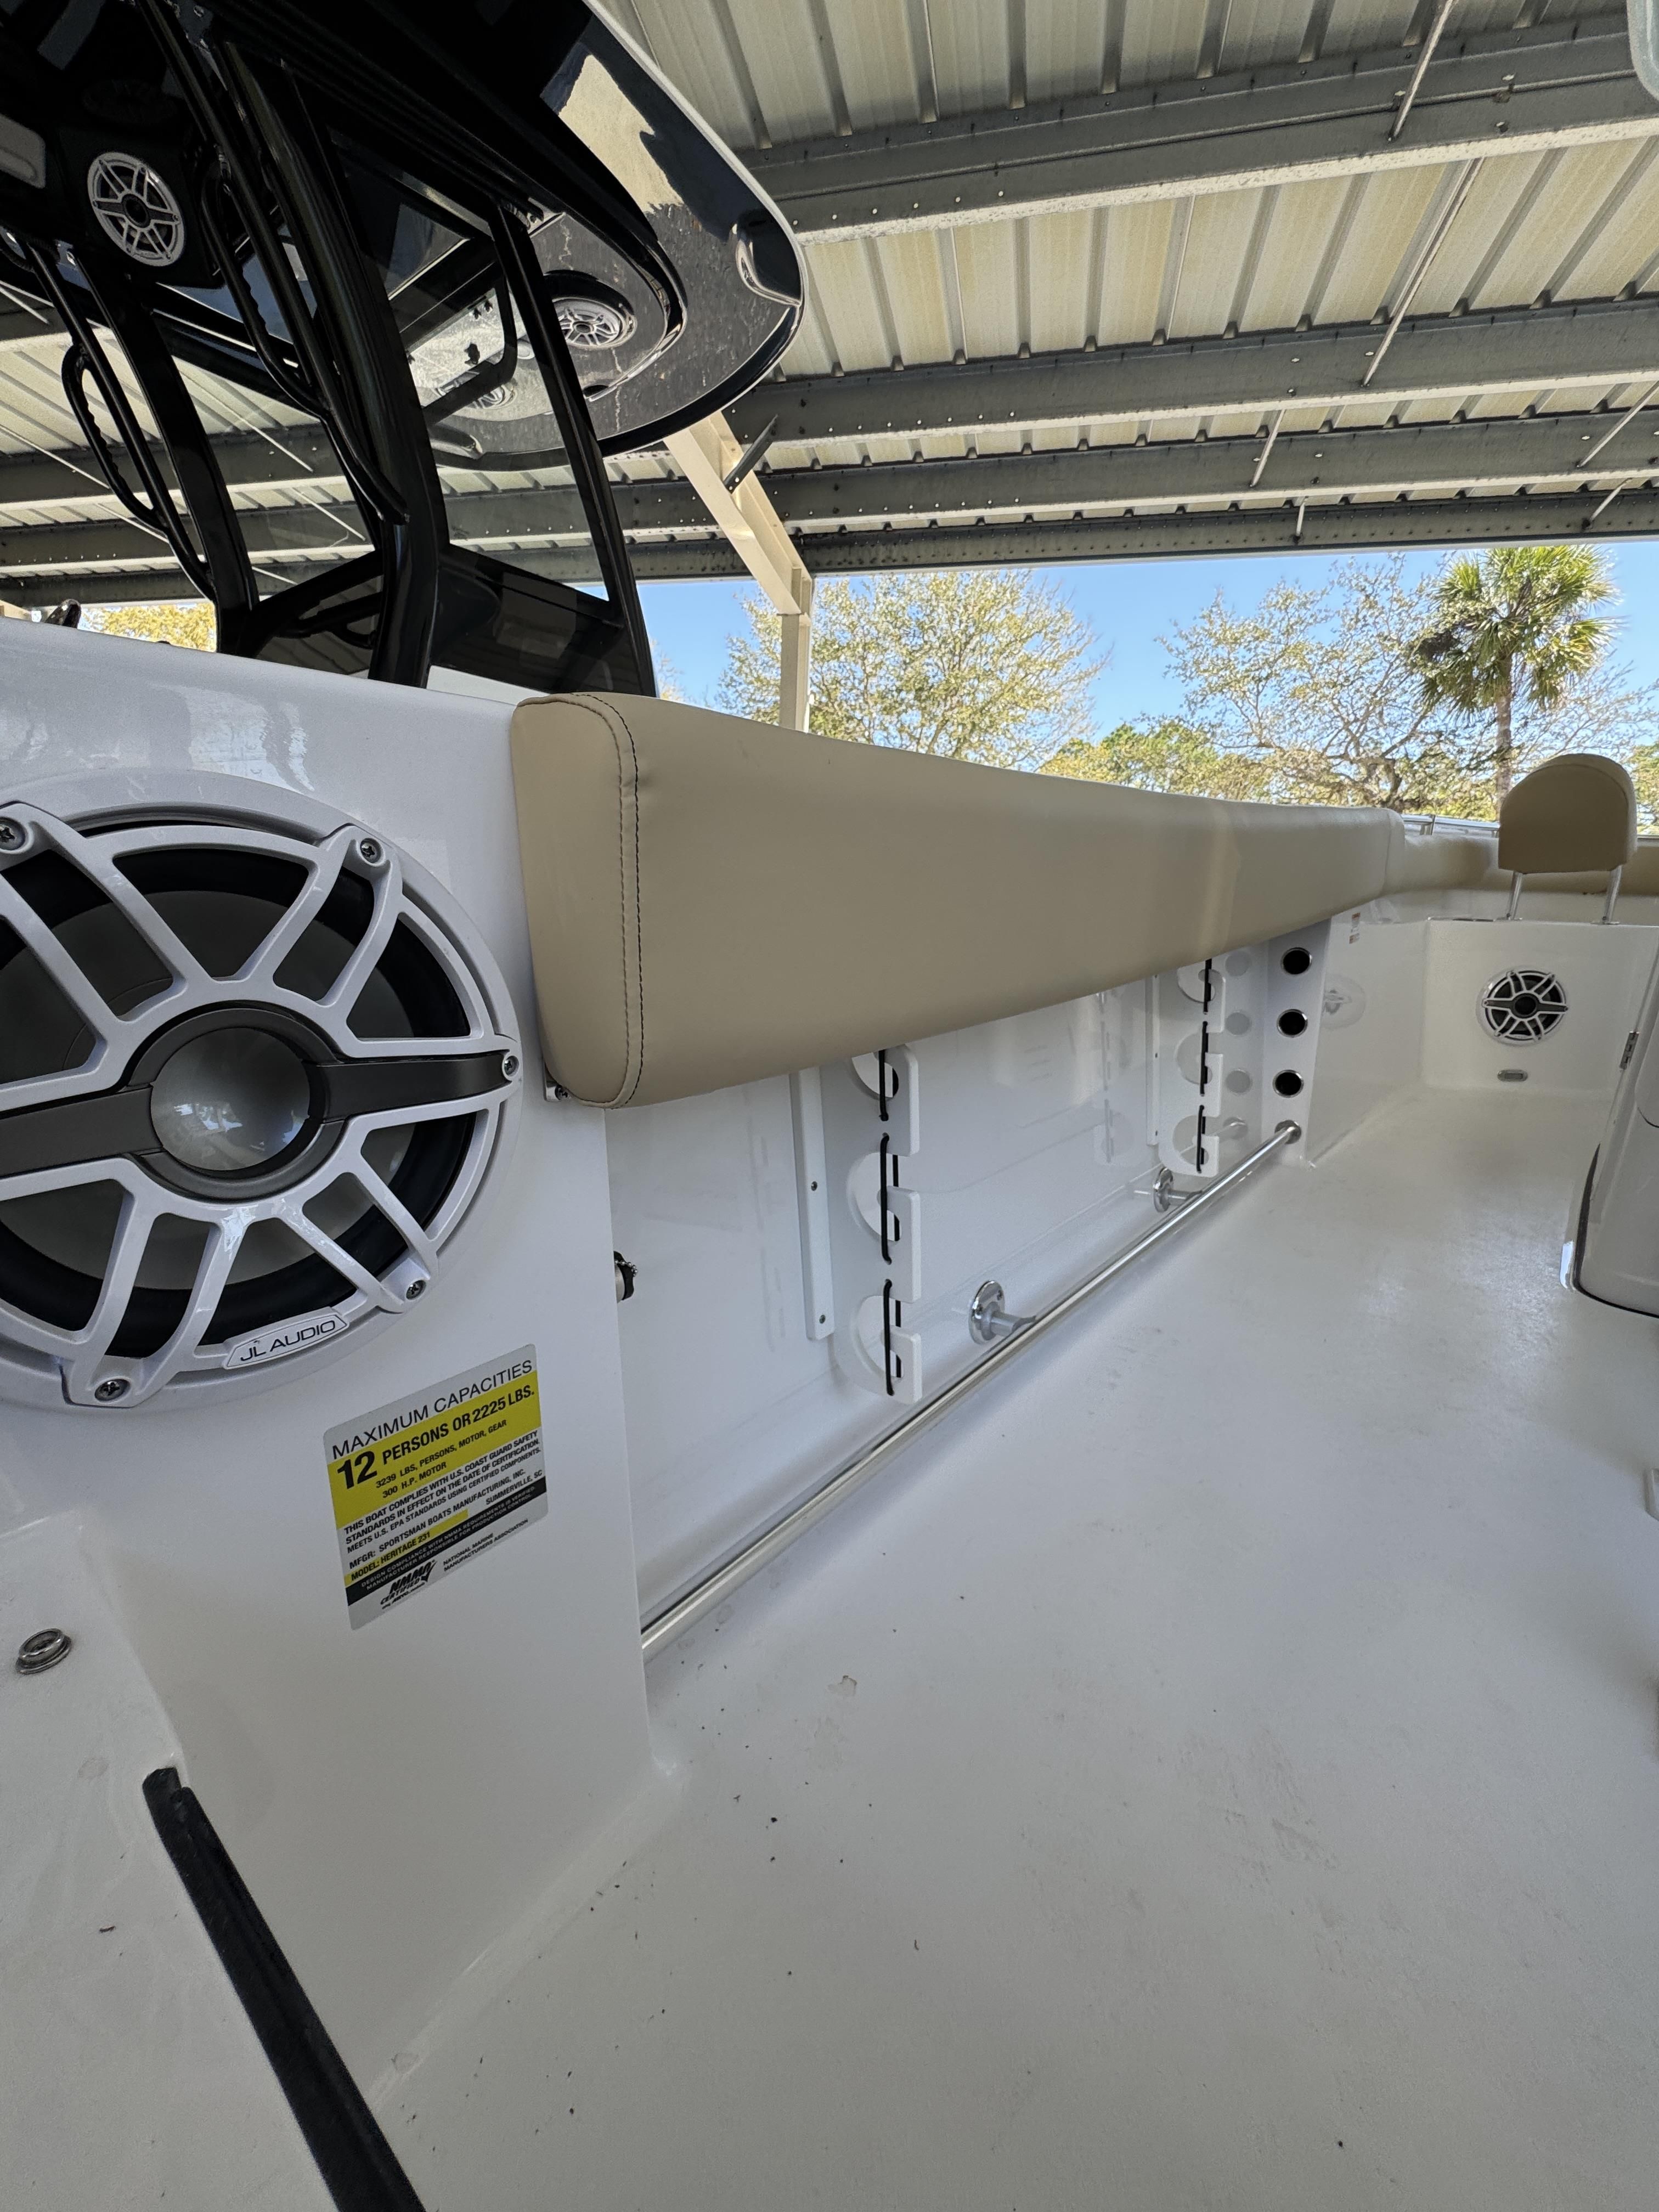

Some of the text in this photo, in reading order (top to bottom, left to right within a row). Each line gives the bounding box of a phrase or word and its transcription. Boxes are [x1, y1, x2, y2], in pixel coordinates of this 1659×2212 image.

[240, 1320, 335, 1361] JL AUDIO
[332, 1360, 532, 1459] MAXIMUM CAPACITIES
[337, 1385, 534, 1489] 12 PERSONS OR 2225 LBS.
[344, 1430, 537, 1534] THIS BOAT COMPLIES WITH U.S. COAST GUARD SAFETY
[376, 1473, 396, 1488] 3239
[419, 1444, 457, 1467] PERSONS,
[459, 1430, 487, 1448] MOTOR,
[488, 1419, 506, 1433] GEAR
[382, 1462, 446, 1498] 300 H.P. MOTOR
[346, 1438, 539, 1544] STANDARDS IN EFFECT ON THE DATE OF CERTIFICATION.
[347, 1447, 540, 1553] MEETS U.S. EPA STANDARDS USING CERTIFIED COMPONENTS.
[486, 1469, 542, 1505] SUMMERVILLE, SC
[349, 1469, 526, 1569] MFGR: SPORTSMAN BOATS MANUFACTURING, INC.
[351, 1531, 430, 1581] MODEL: HERITAGE 231
[443, 1547, 471, 1565] NATIONAL
[444, 1539, 493, 1571] MANUFACTURERS
[380, 1578, 420, 1605] CERTIFIED
